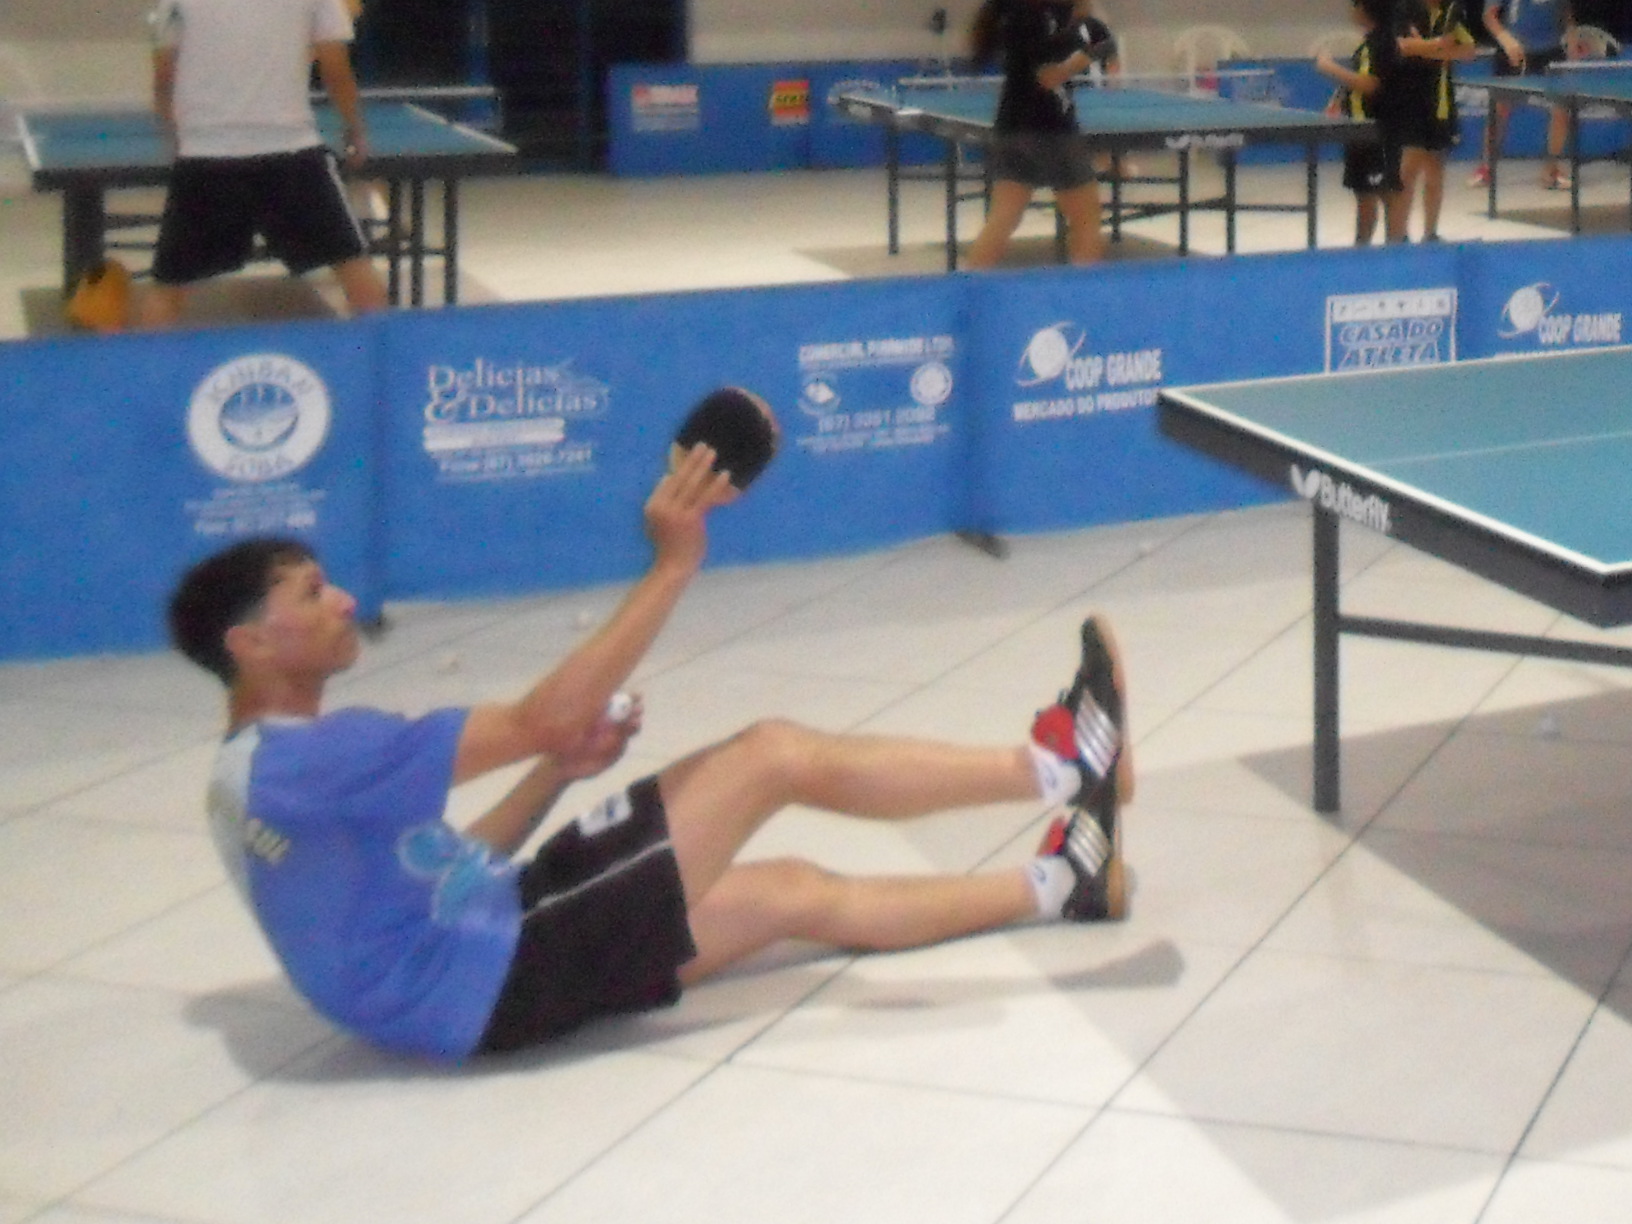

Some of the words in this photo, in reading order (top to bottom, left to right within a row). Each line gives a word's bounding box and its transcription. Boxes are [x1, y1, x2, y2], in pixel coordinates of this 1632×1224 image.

[1339, 319, 1404, 347] CASA
[1406, 316, 1444, 340] DO
[1064, 354, 1103, 391] COOP
[1106, 348, 1162, 387] GRANDE
[469, 368, 598, 418] Delicias
[1319, 473, 1390, 533] Butterfly
